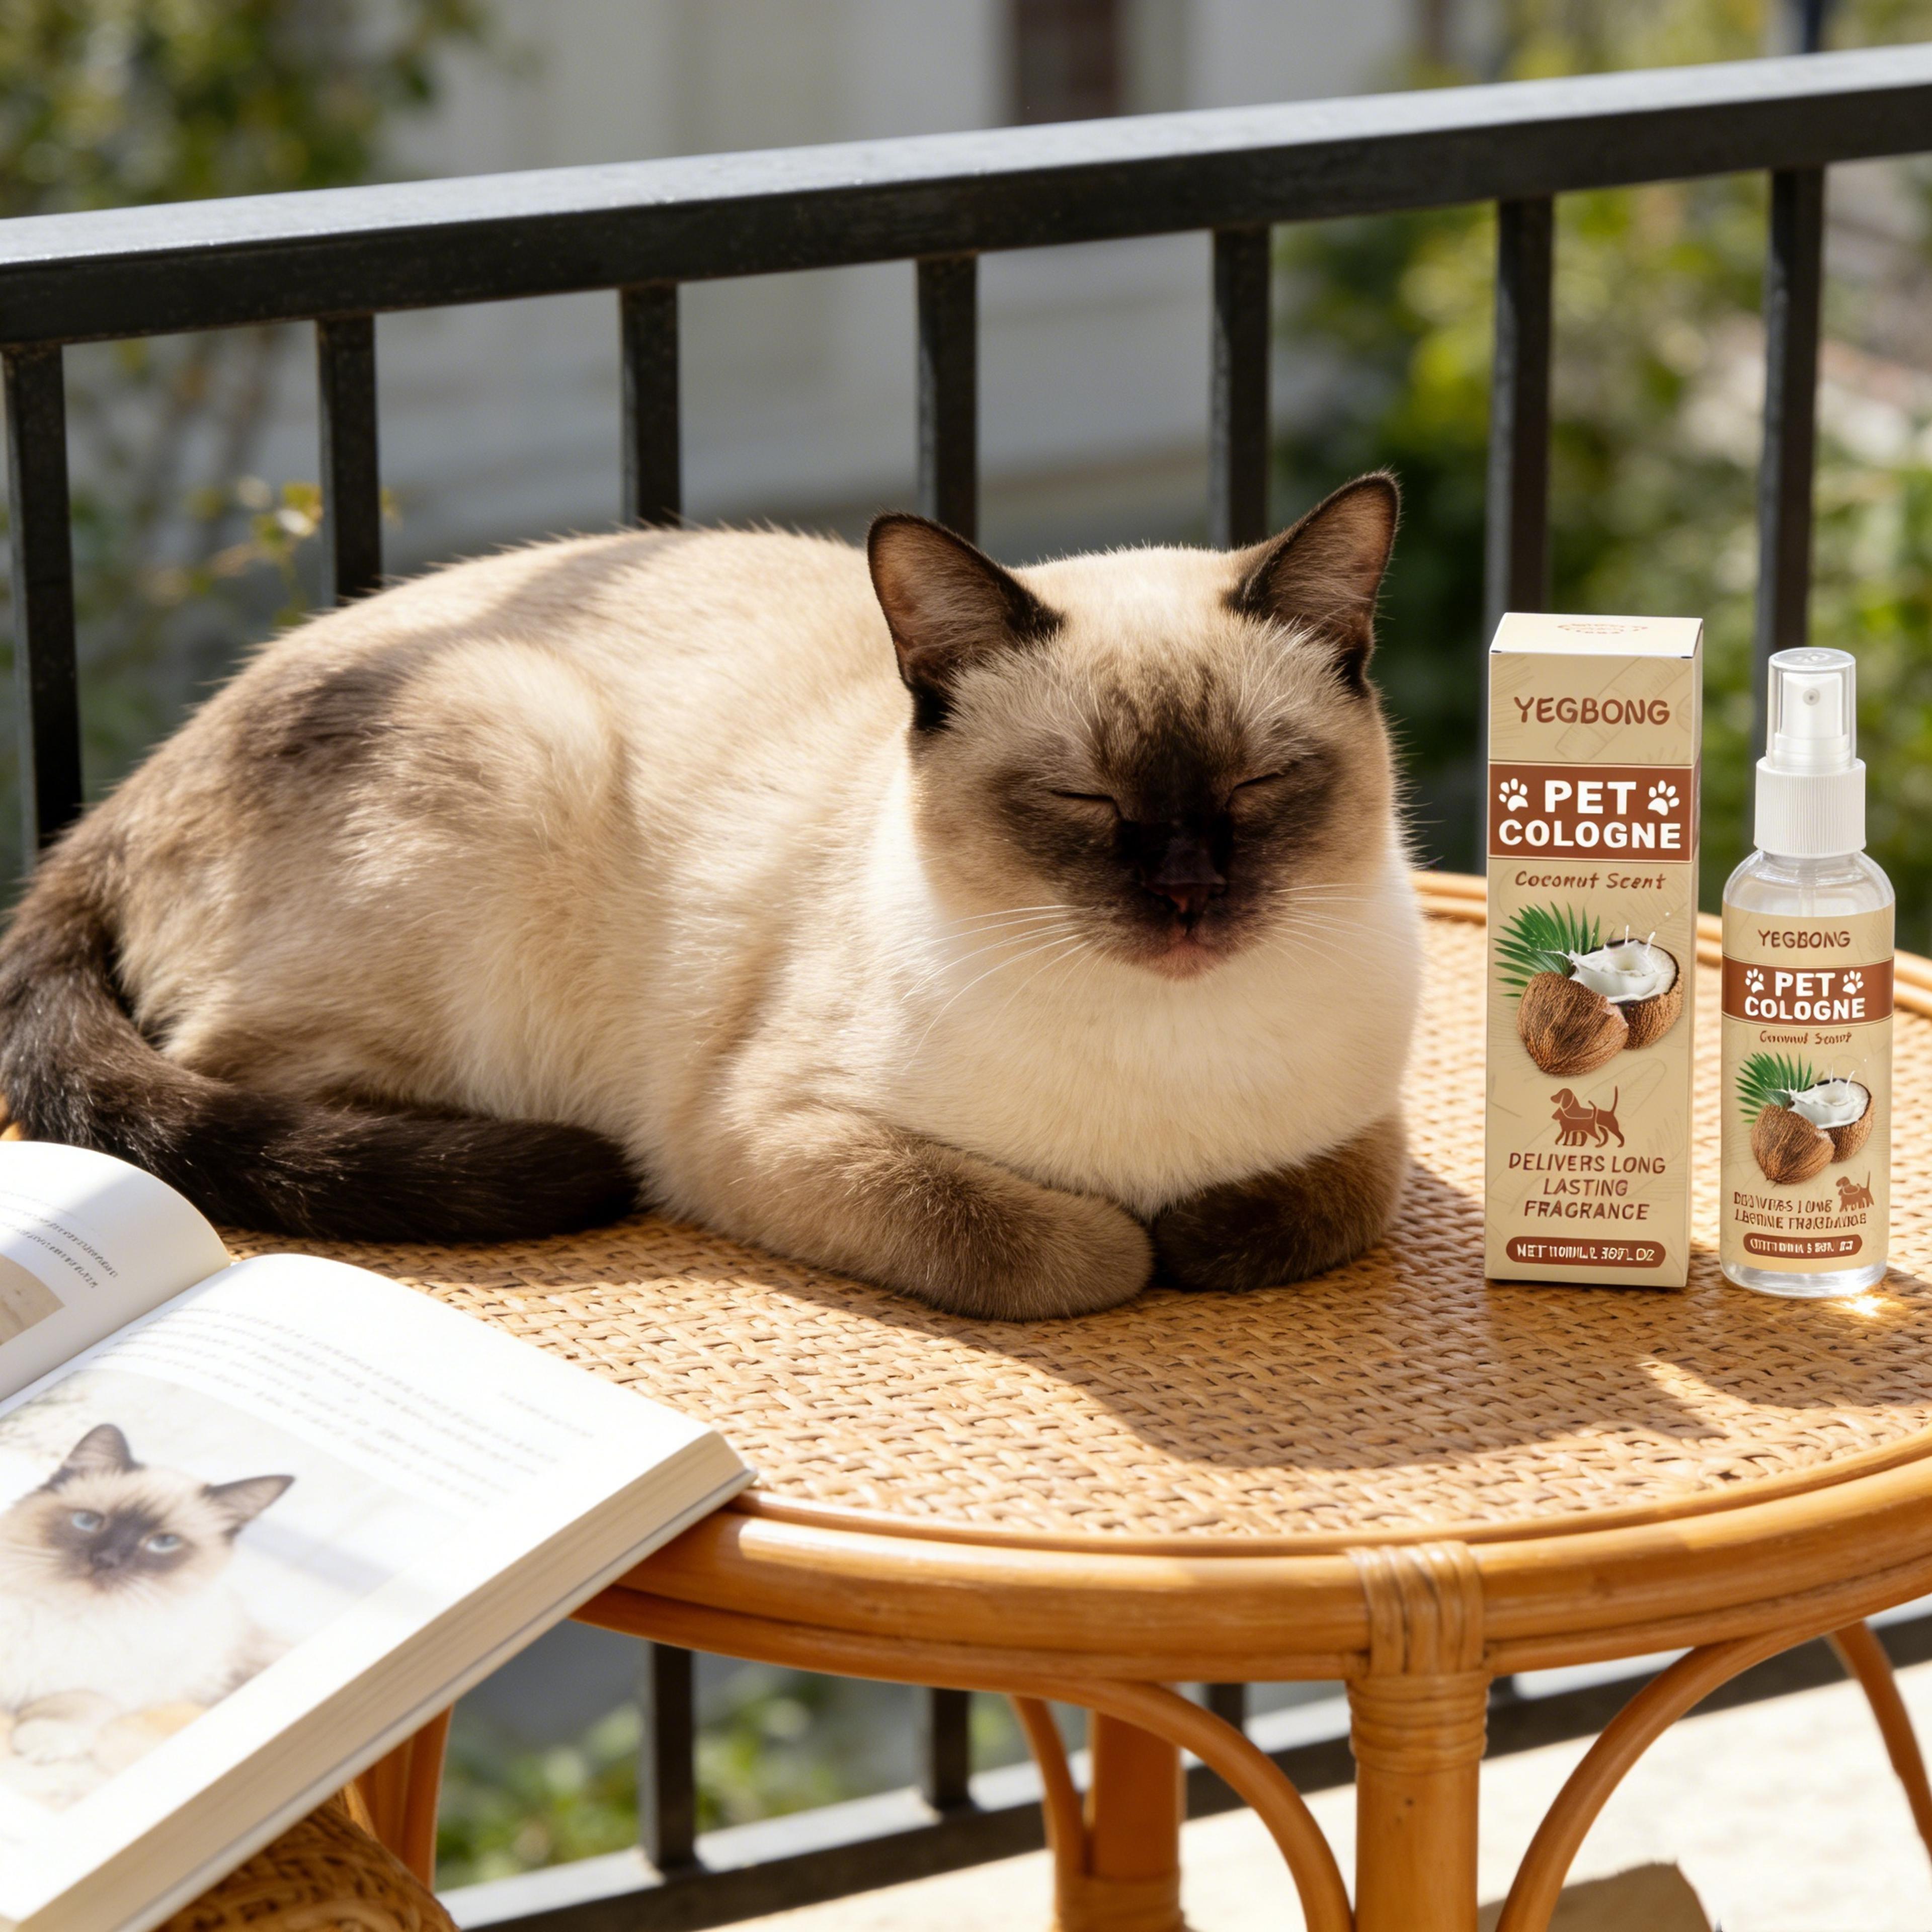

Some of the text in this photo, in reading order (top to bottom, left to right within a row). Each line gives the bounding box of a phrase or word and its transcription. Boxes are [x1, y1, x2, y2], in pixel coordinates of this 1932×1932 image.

[1513, 696, 1670, 726] YEGBONG
[1545, 780, 1637, 815] PET
[1499, 819, 1681, 849] COLOGNE
[1515, 870, 1666, 890] Coconut Scent
[1758, 929, 1850, 948] YEGBONG
[1775, 971, 1835, 997] PET
[1744, 996, 1866, 1020] COLOGNE
[1509, 1152, 1666, 1174] DELIVERS LONG
[1543, 1178, 1628, 1197] LASTING
[1524, 1200, 1650, 1220] FRAGRANCE
[1517, 1244, 1547, 1258] NET
